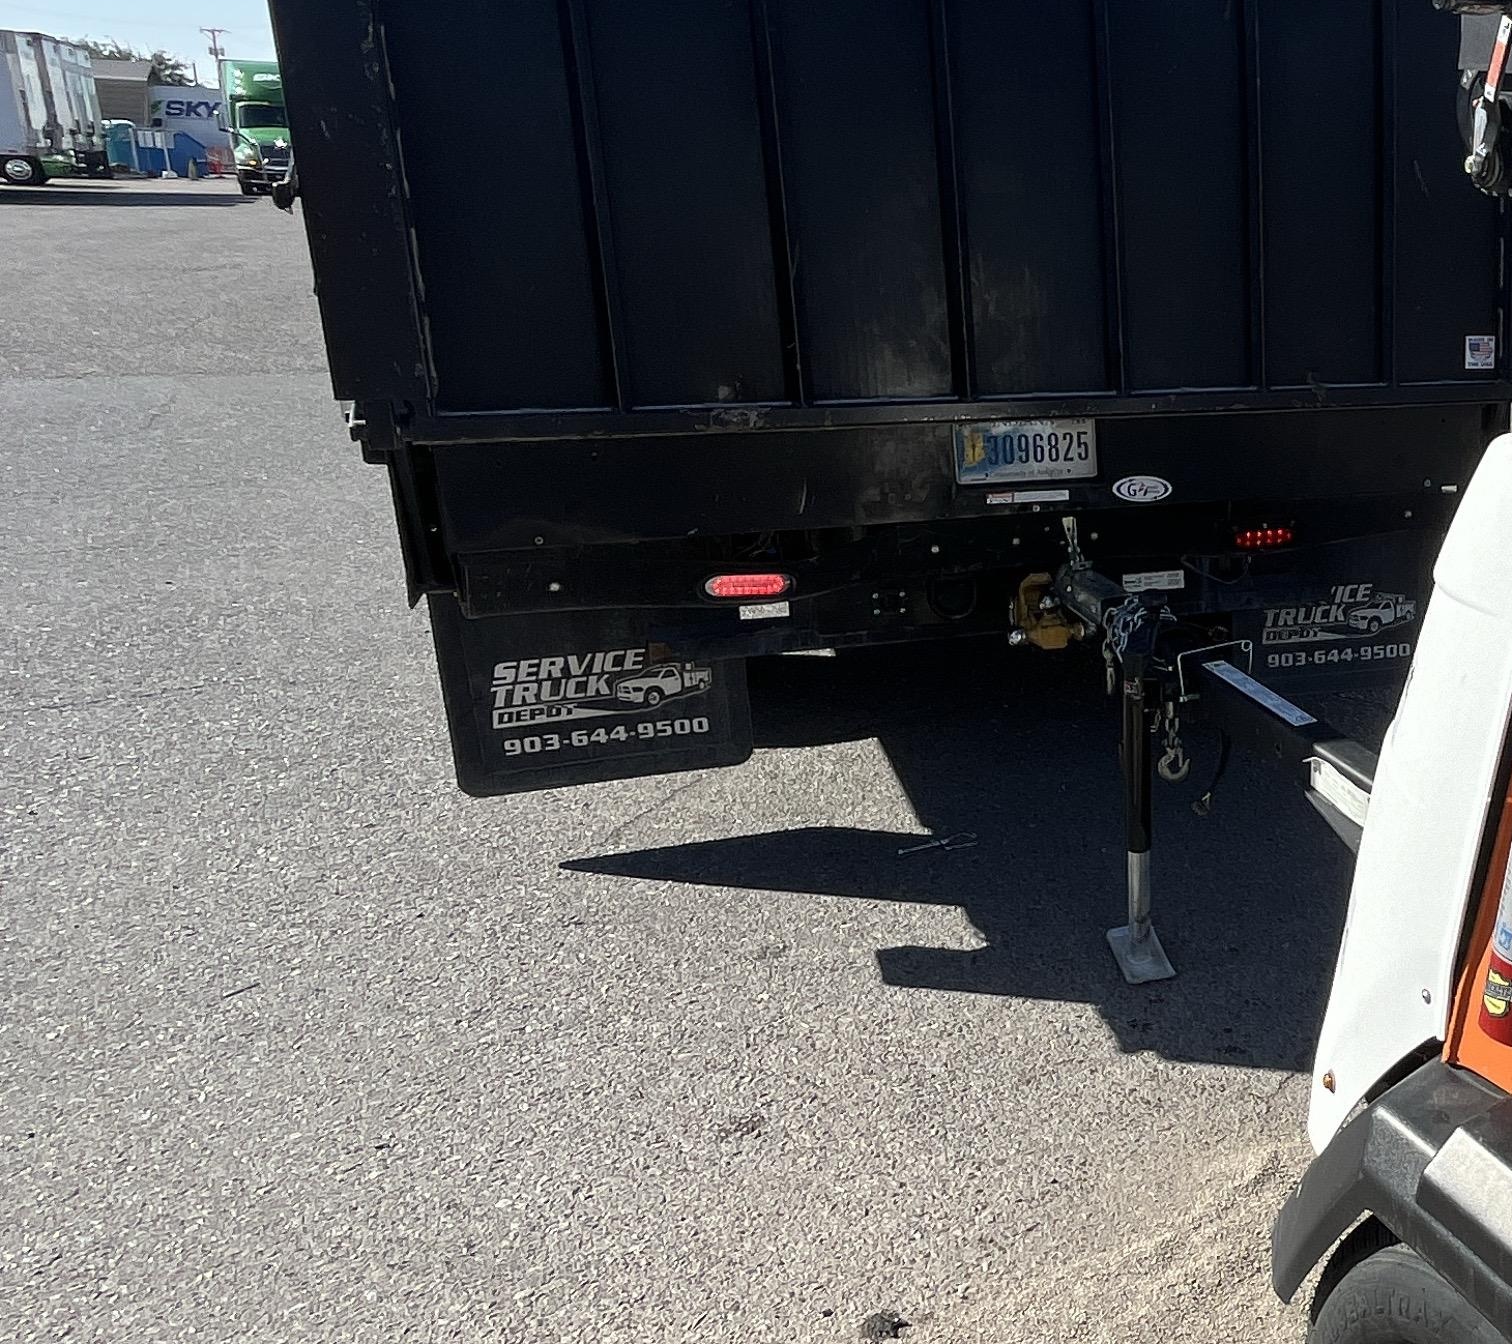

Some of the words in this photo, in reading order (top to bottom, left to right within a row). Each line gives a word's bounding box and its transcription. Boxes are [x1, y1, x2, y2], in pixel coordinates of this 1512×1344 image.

[165, 99, 222, 119] SKY
[987, 431, 1090, 464] 3096825
[1263, 602, 1348, 628] TRUCK
[492, 647, 646, 686] SERVICE
[1266, 643, 1412, 669] 903-644-9500
[490, 673, 613, 709] TRUCK
[497, 703, 579, 726] DEPOT
[503, 717, 711, 757] 903-644-9500
